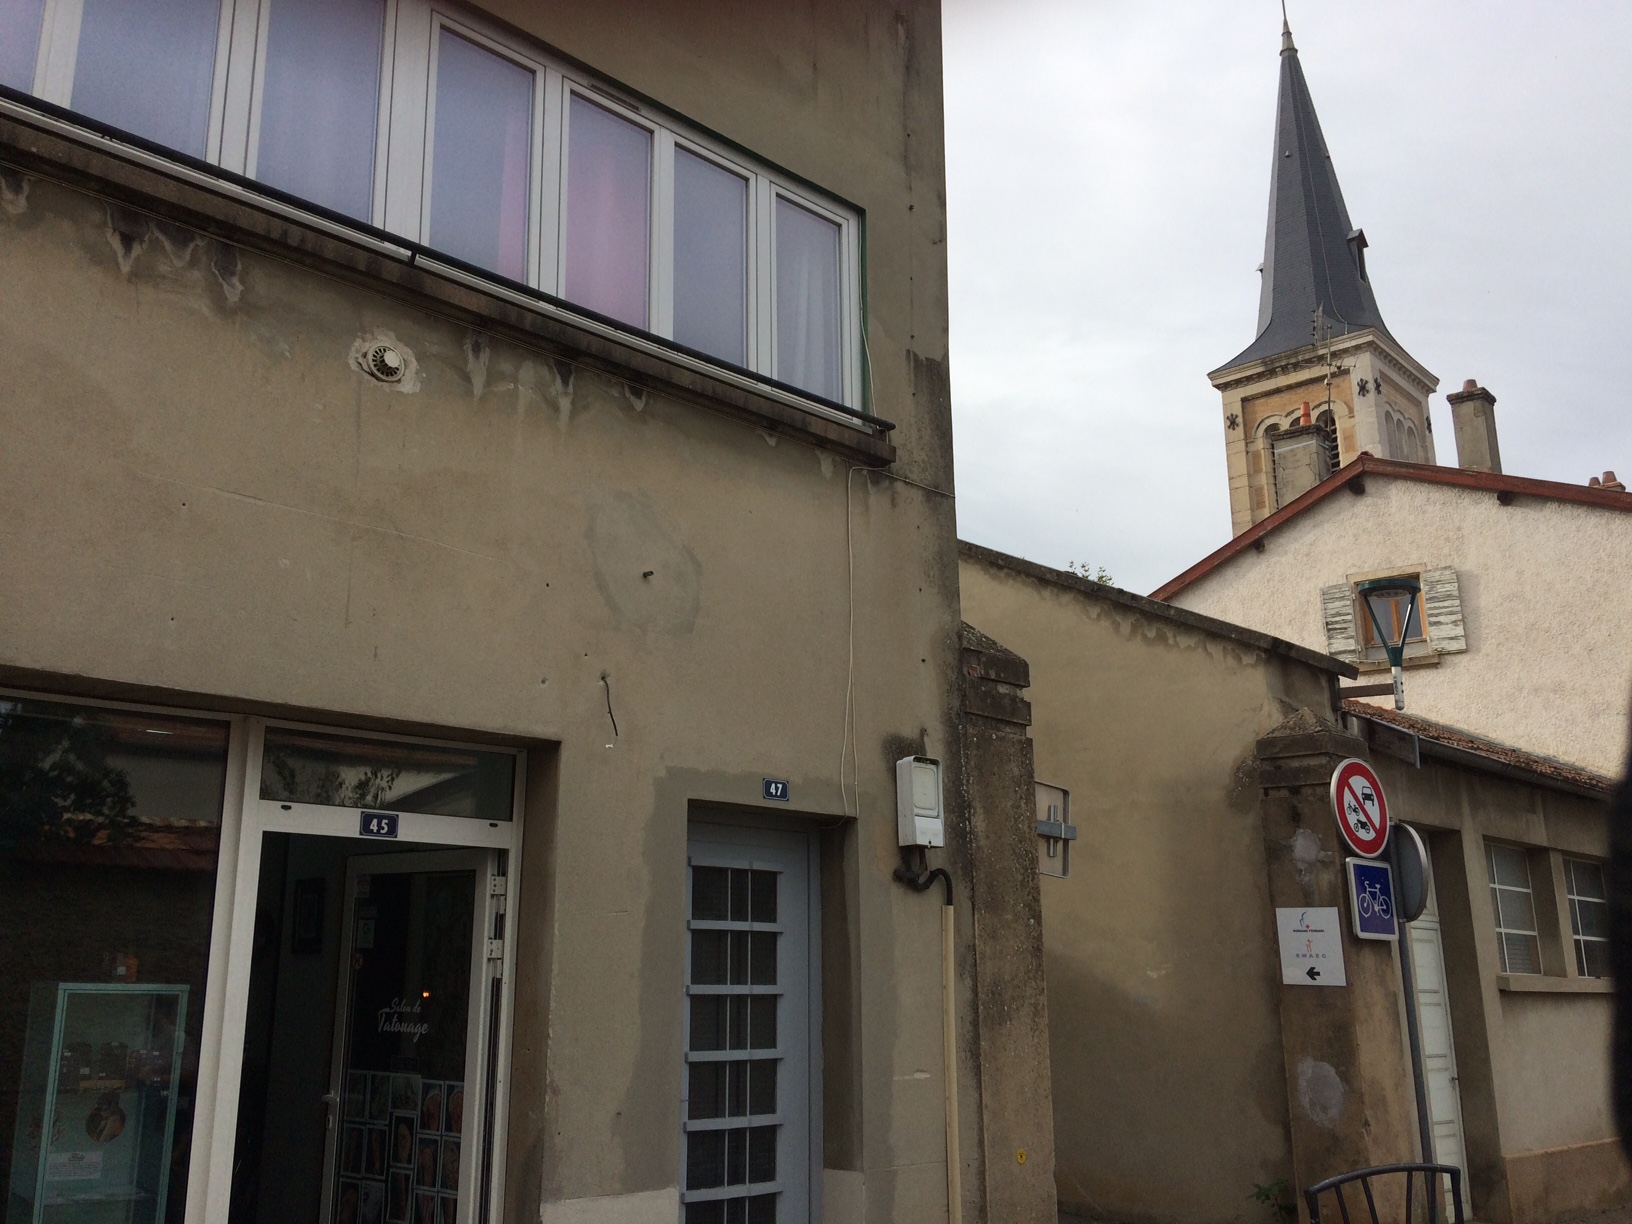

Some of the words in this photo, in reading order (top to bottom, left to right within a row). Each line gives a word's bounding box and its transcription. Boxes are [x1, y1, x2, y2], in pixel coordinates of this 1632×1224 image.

[770, 783, 783, 796] 47
[370, 818, 389, 834] 45
[411, 999, 422, 1013] de
[378, 1007, 429, 1043] Tatouage
